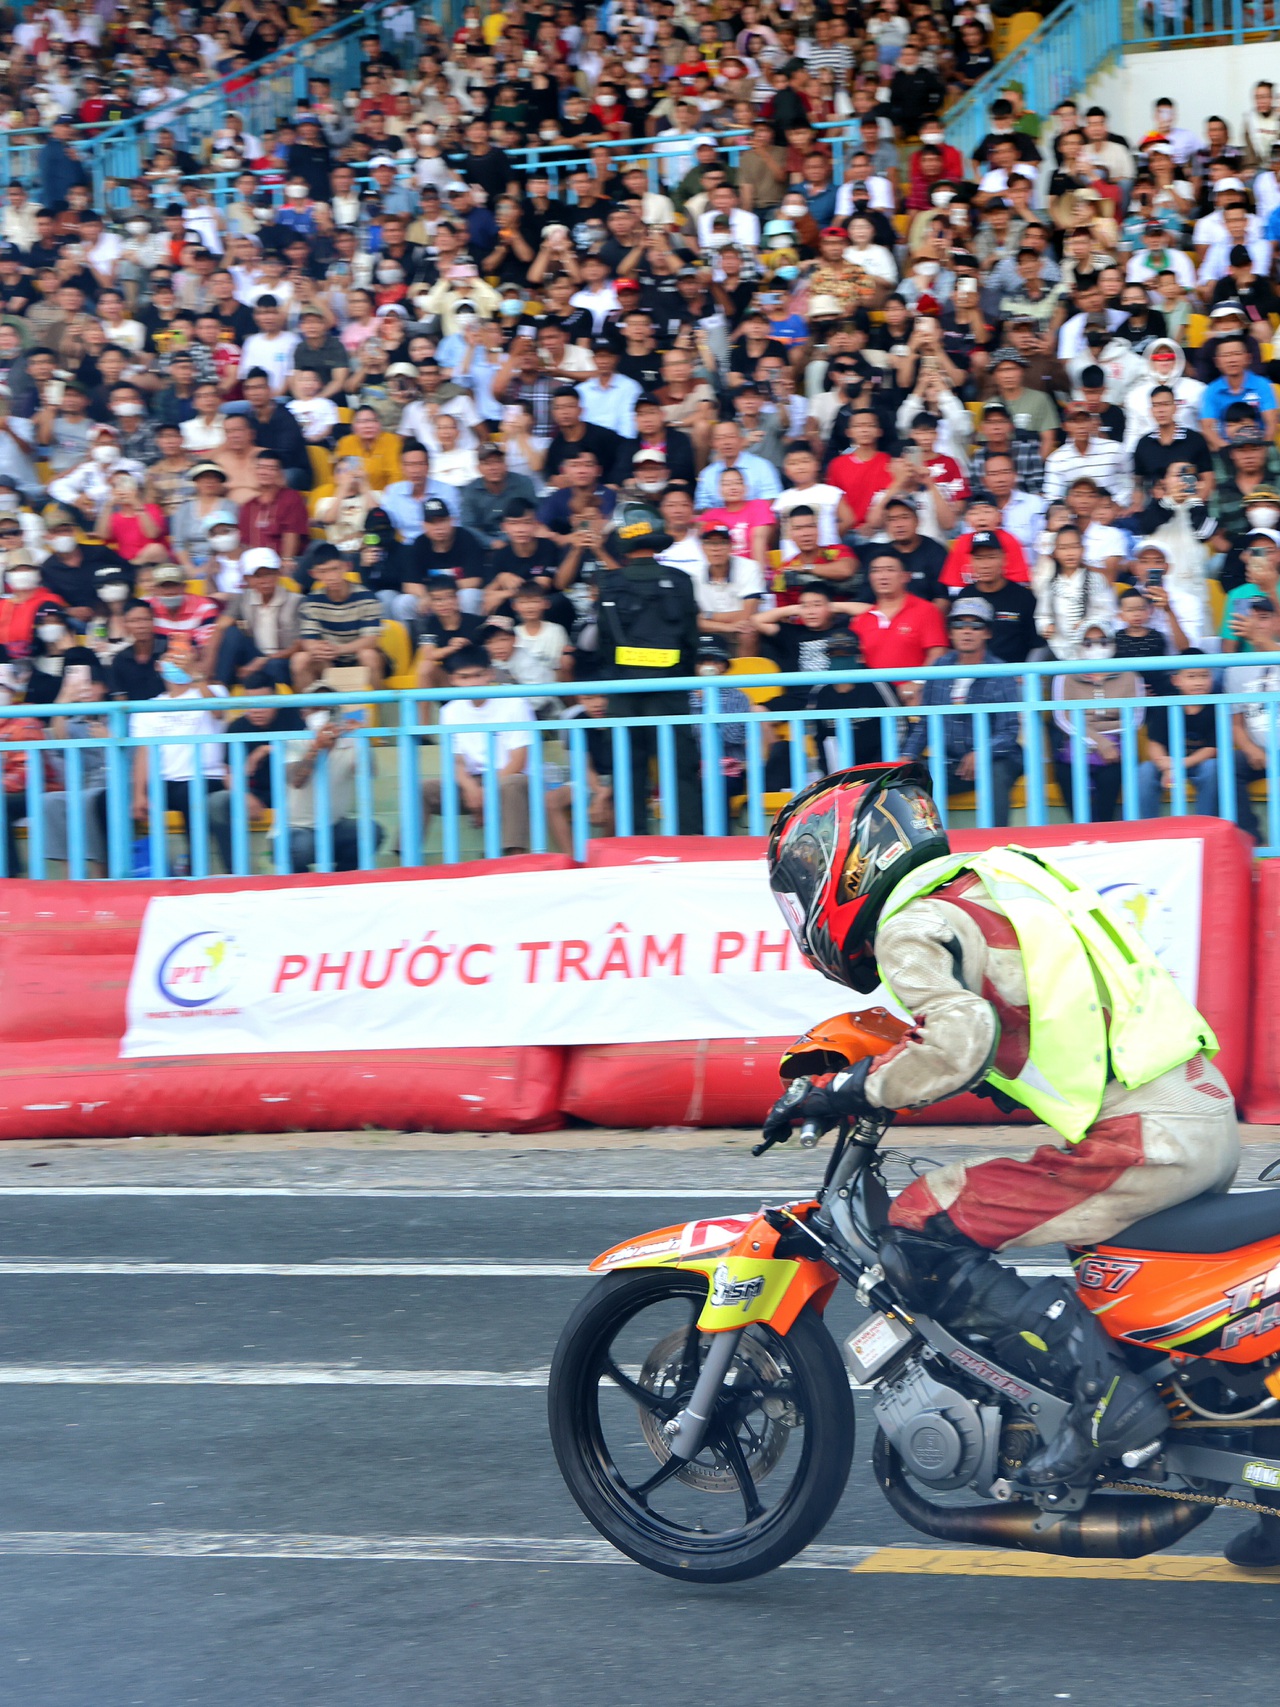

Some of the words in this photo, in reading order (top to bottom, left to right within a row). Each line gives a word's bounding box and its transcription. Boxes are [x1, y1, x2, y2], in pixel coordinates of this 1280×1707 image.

[165, 965, 213, 985] PT
[271, 930, 493, 993] PHƯỚC
[516, 922, 686, 984] TRÂM
[710, 929, 818, 974] PH
[1079, 1257, 1143, 1293] 67
